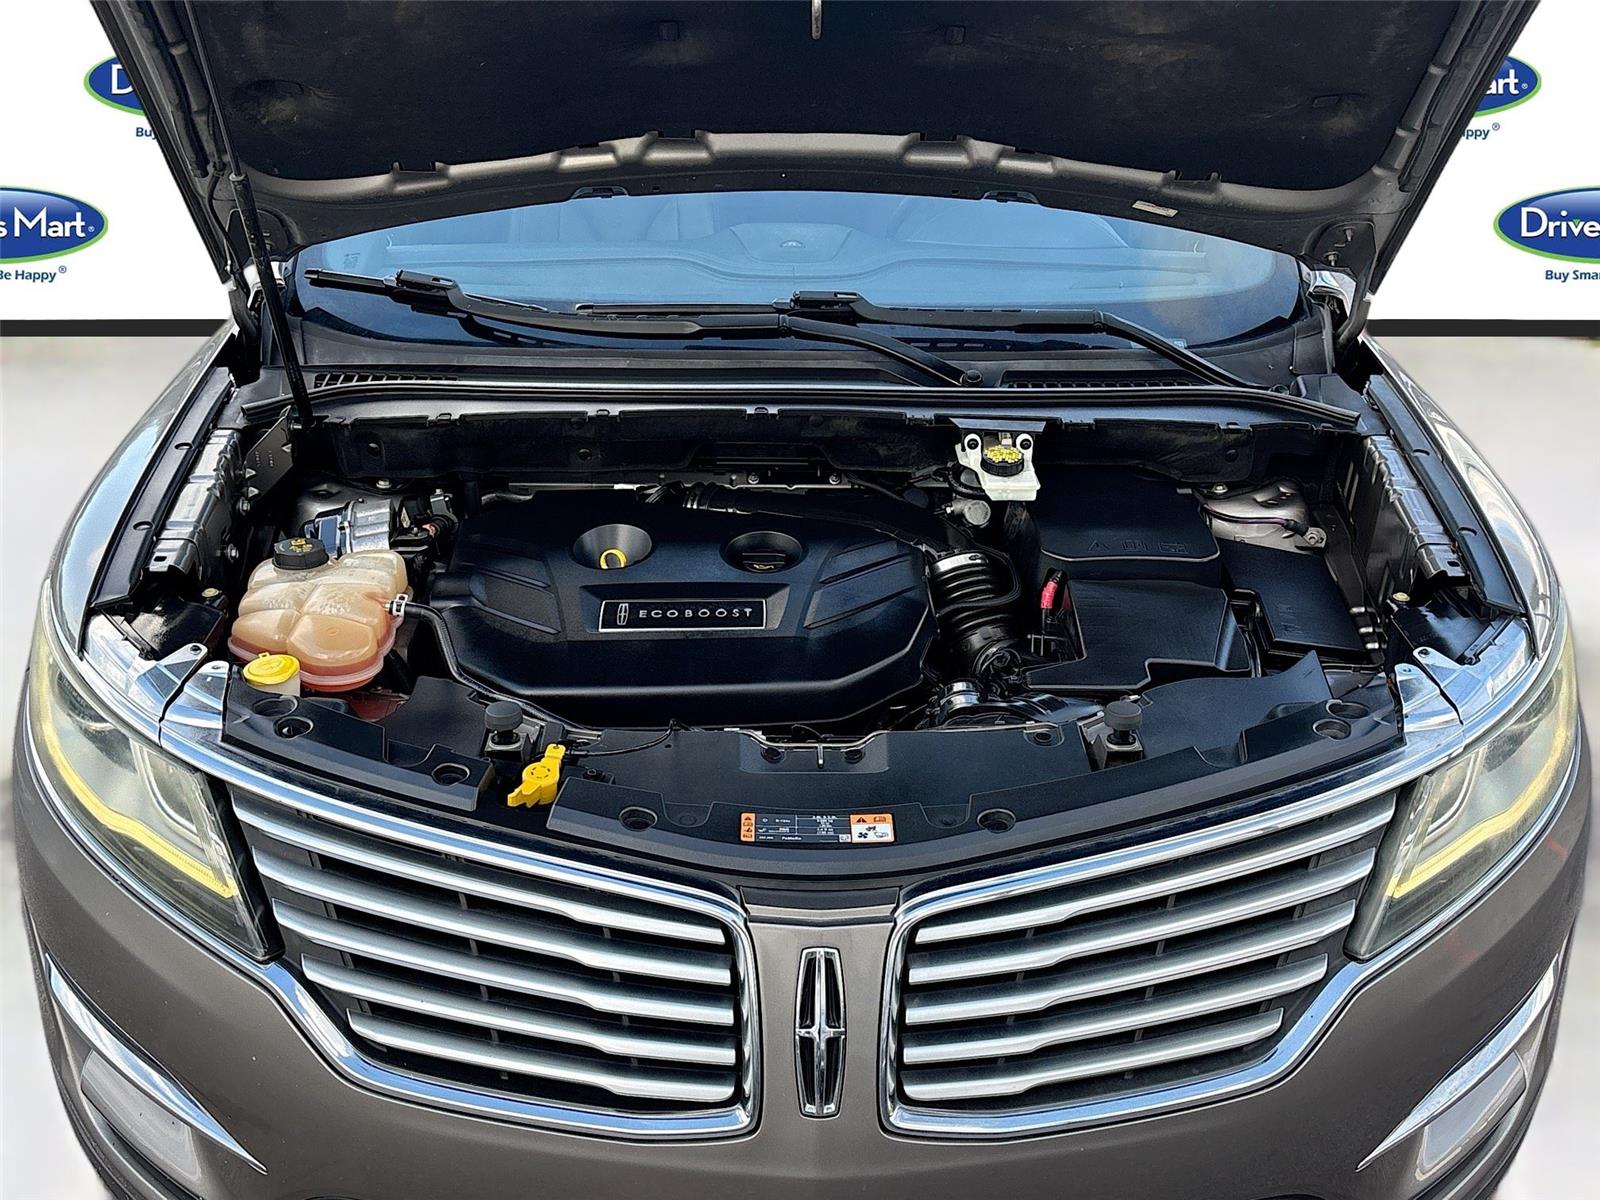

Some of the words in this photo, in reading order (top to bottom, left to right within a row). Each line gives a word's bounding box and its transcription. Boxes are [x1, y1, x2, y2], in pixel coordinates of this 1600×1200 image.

[1462, 129, 1490, 140] ppy
[13, 206, 86, 238] Mart
[1520, 206, 1600, 238] Drive
[15, 270, 57, 283] Happy
[1545, 269, 1569, 283] Buy
[639, 607, 753, 618] ECOBOOST
